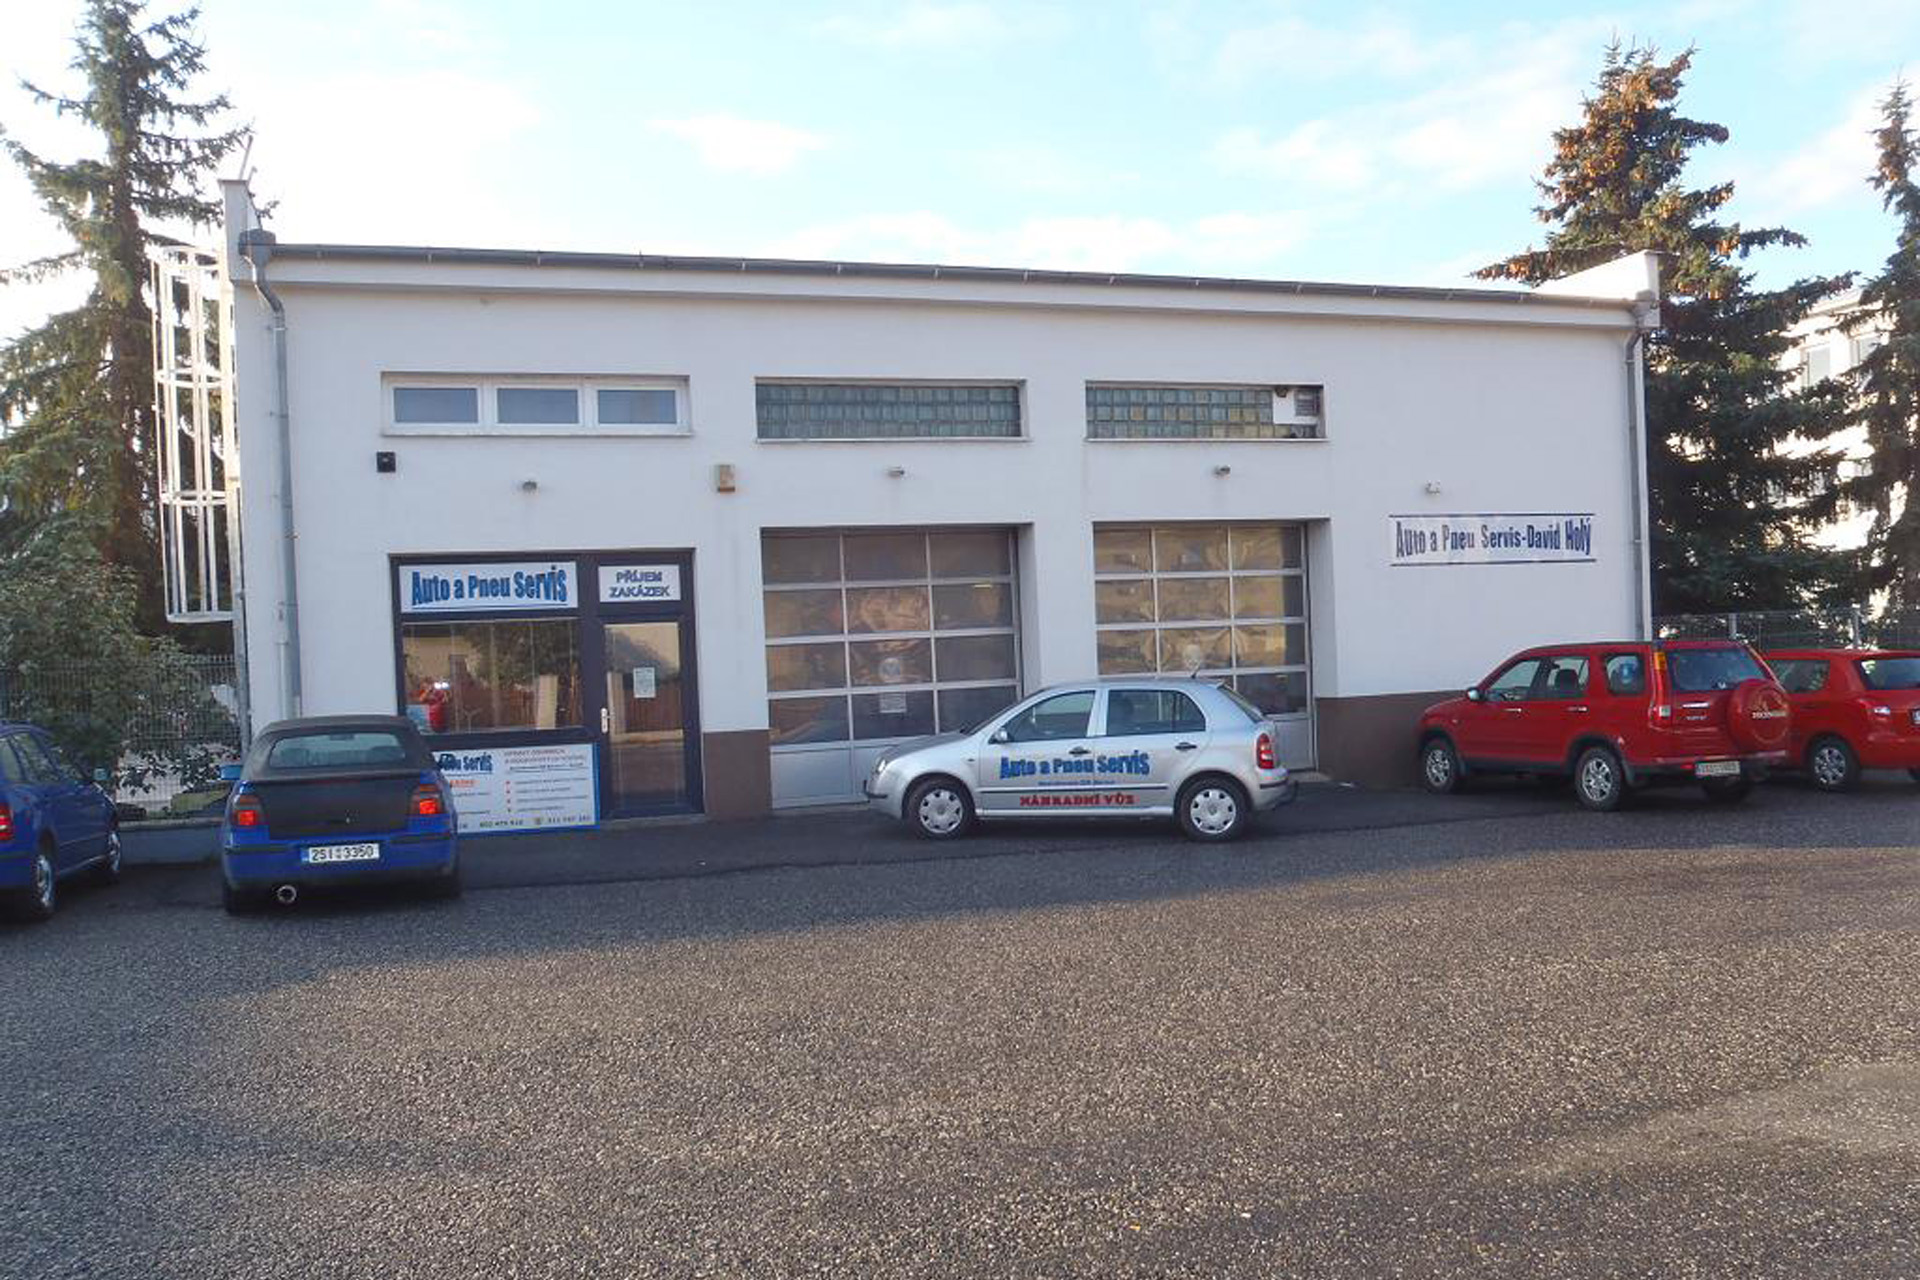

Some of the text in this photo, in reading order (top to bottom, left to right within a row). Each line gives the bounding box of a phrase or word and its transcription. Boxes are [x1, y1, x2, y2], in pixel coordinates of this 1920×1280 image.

[1395, 520, 1427, 558] Auto
[1430, 530, 1438, 552] a
[1442, 524, 1475, 551] Pneu
[1565, 517, 1592, 556] Holý
[411, 565, 568, 606] Auto a Pneu Servis
[616, 569, 663, 583] PŘÍJEM
[609, 584, 671, 598] ZAKÁZEK
[1000, 750, 1151, 779] Auto a Pneu Servis
